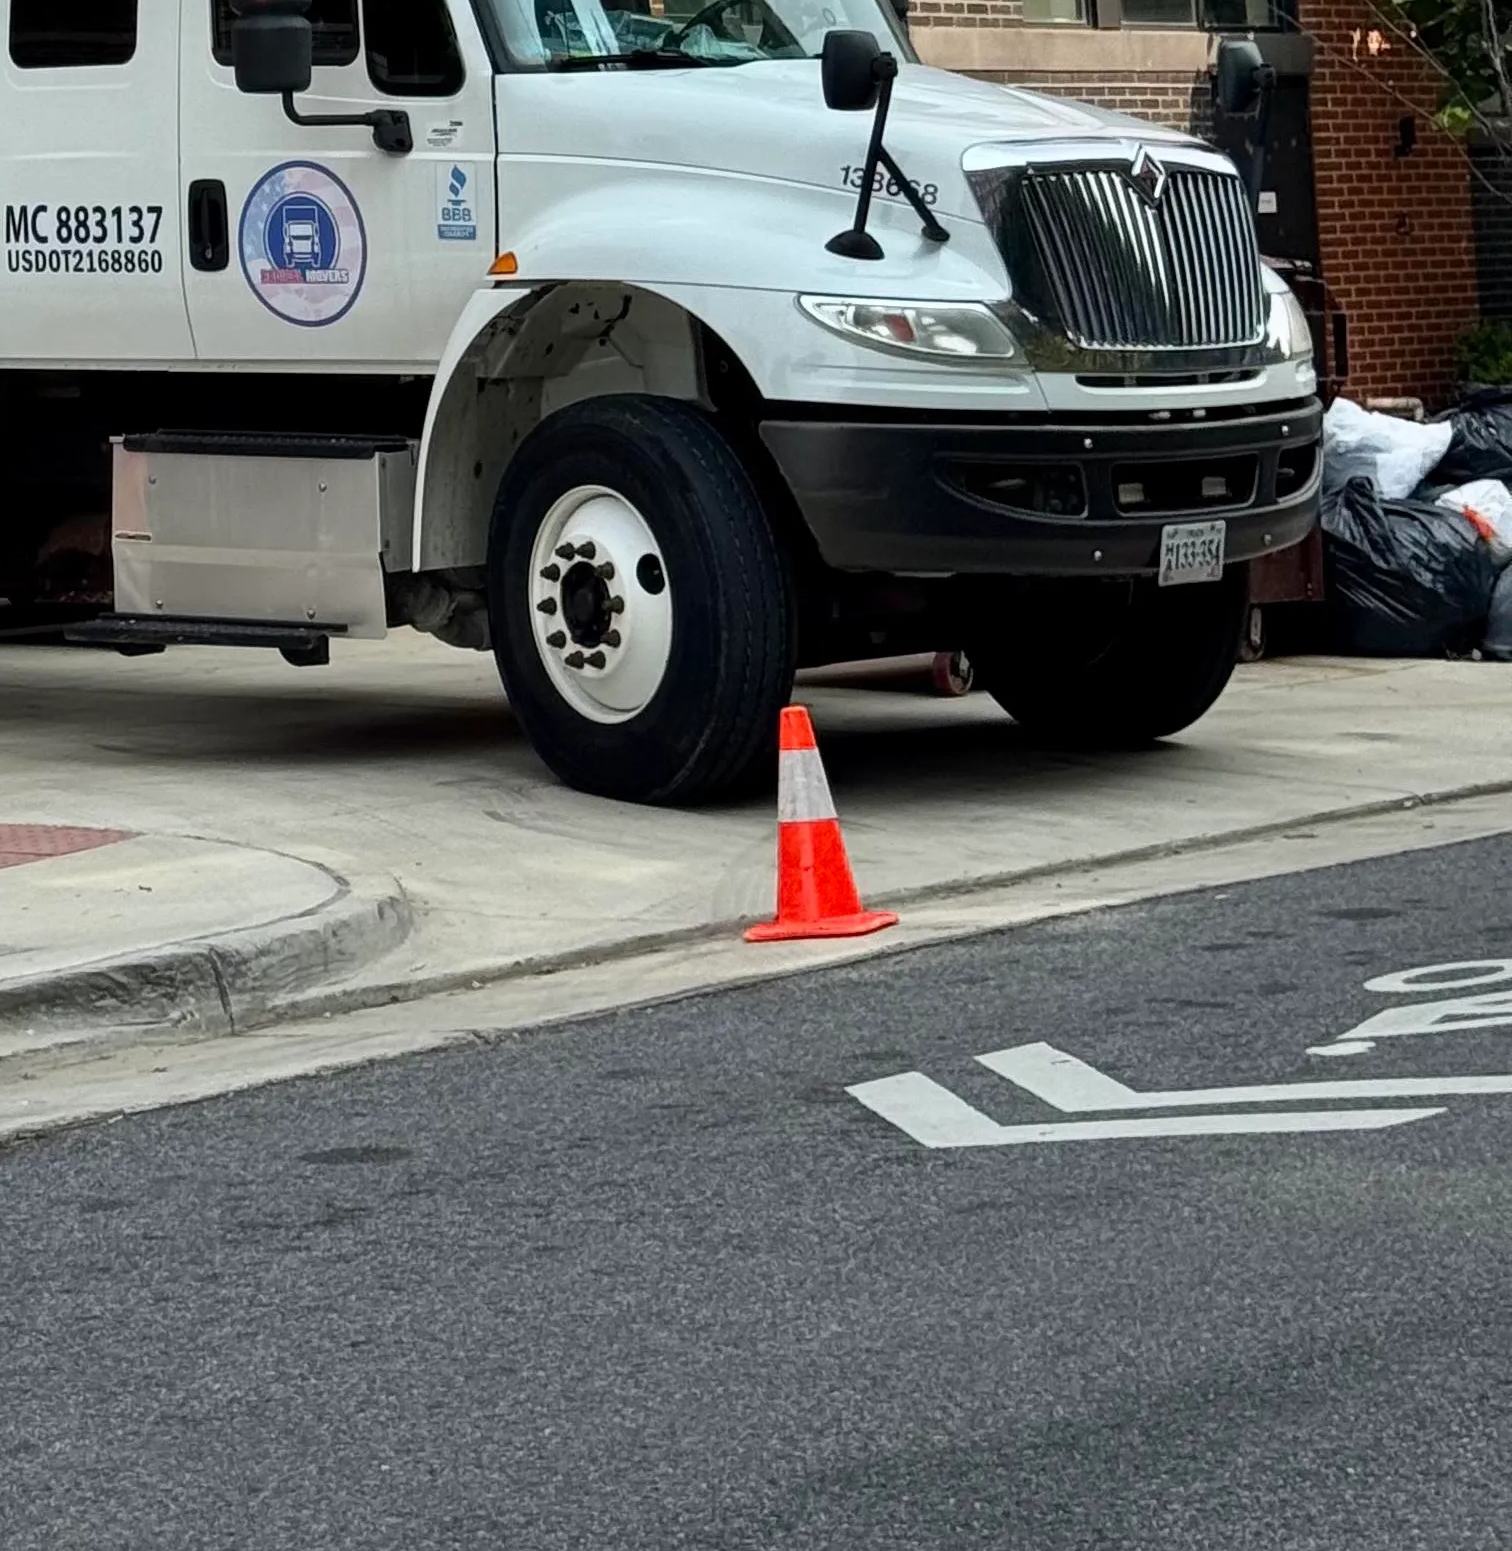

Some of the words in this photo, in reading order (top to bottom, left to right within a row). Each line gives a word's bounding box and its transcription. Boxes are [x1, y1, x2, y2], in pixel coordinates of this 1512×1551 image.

[5, 205, 48, 244] MC
[56, 205, 163, 244] 883137
[441, 207, 472, 222] BBB
[7, 249, 163, 273] USDOT2168860
